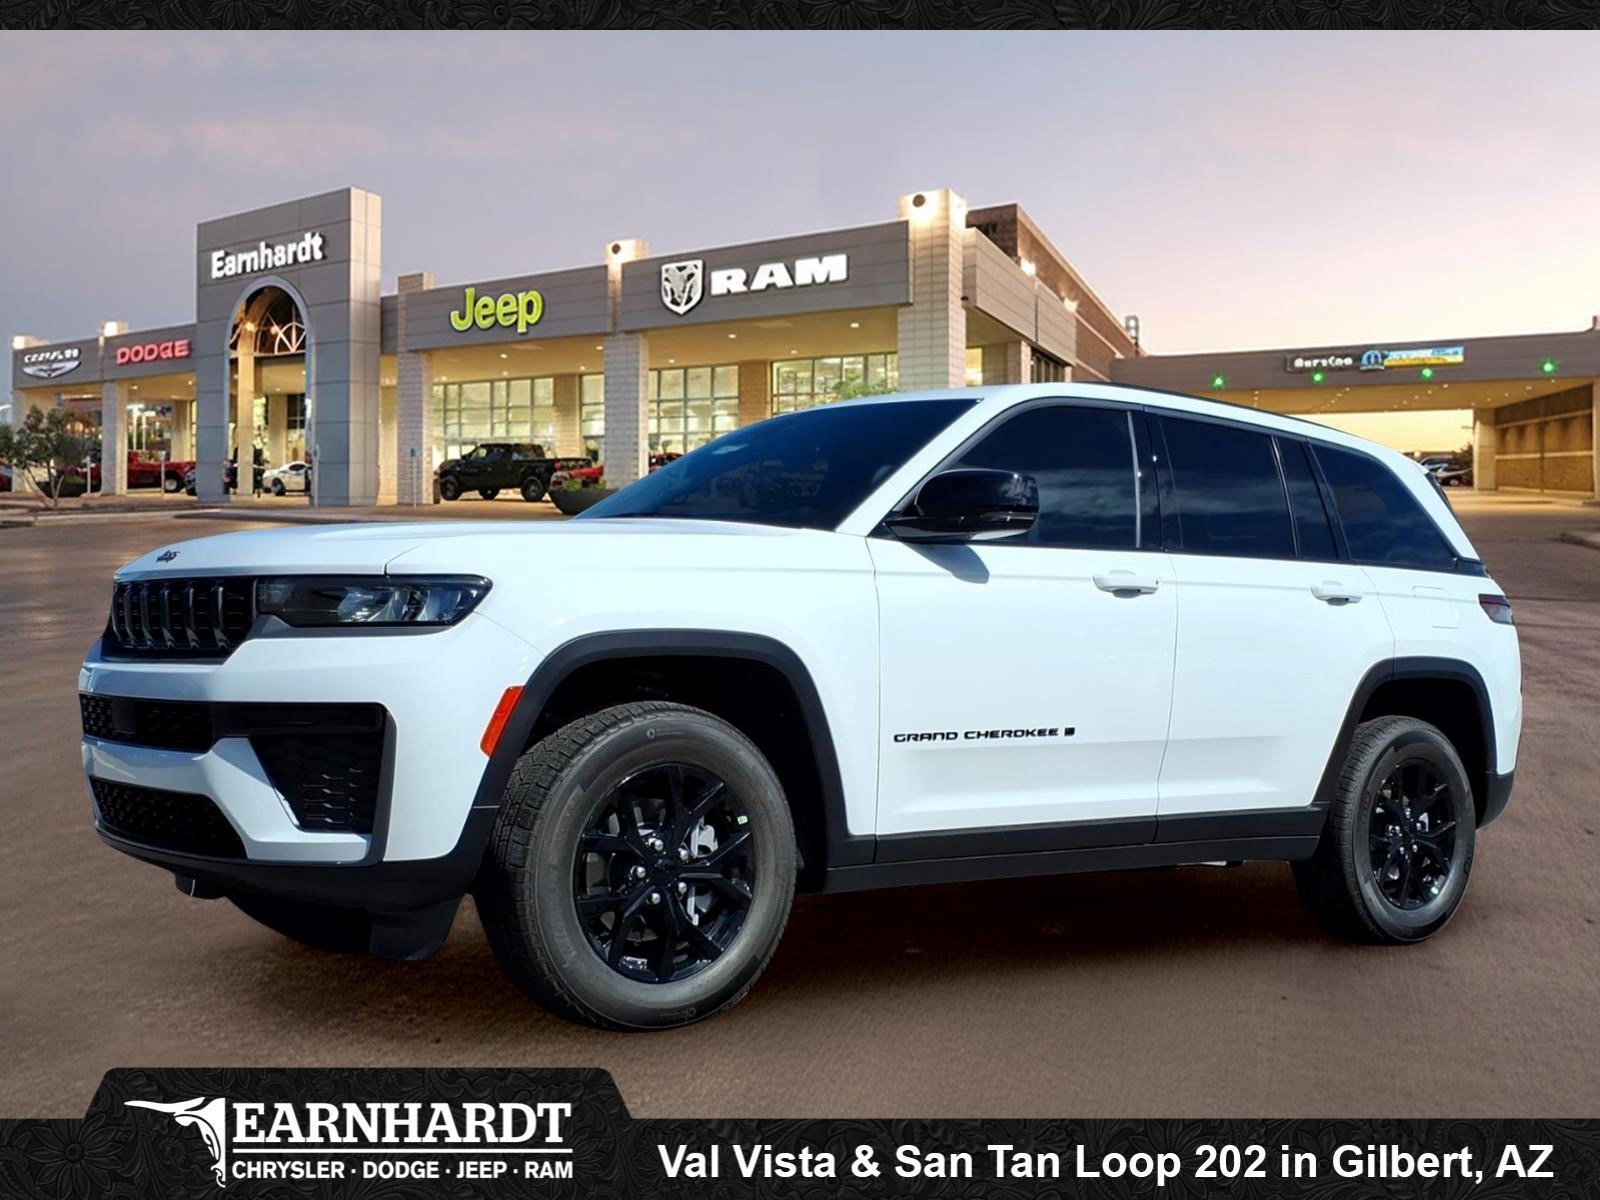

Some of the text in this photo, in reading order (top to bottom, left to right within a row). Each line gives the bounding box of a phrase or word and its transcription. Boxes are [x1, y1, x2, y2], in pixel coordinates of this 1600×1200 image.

[210, 231, 325, 280] Earnhardt
[710, 253, 848, 296] RAM
[450, 287, 544, 335] Jeep
[116, 339, 190, 365] DODGE
[893, 727, 1059, 743] GRAND CHEROKEE
